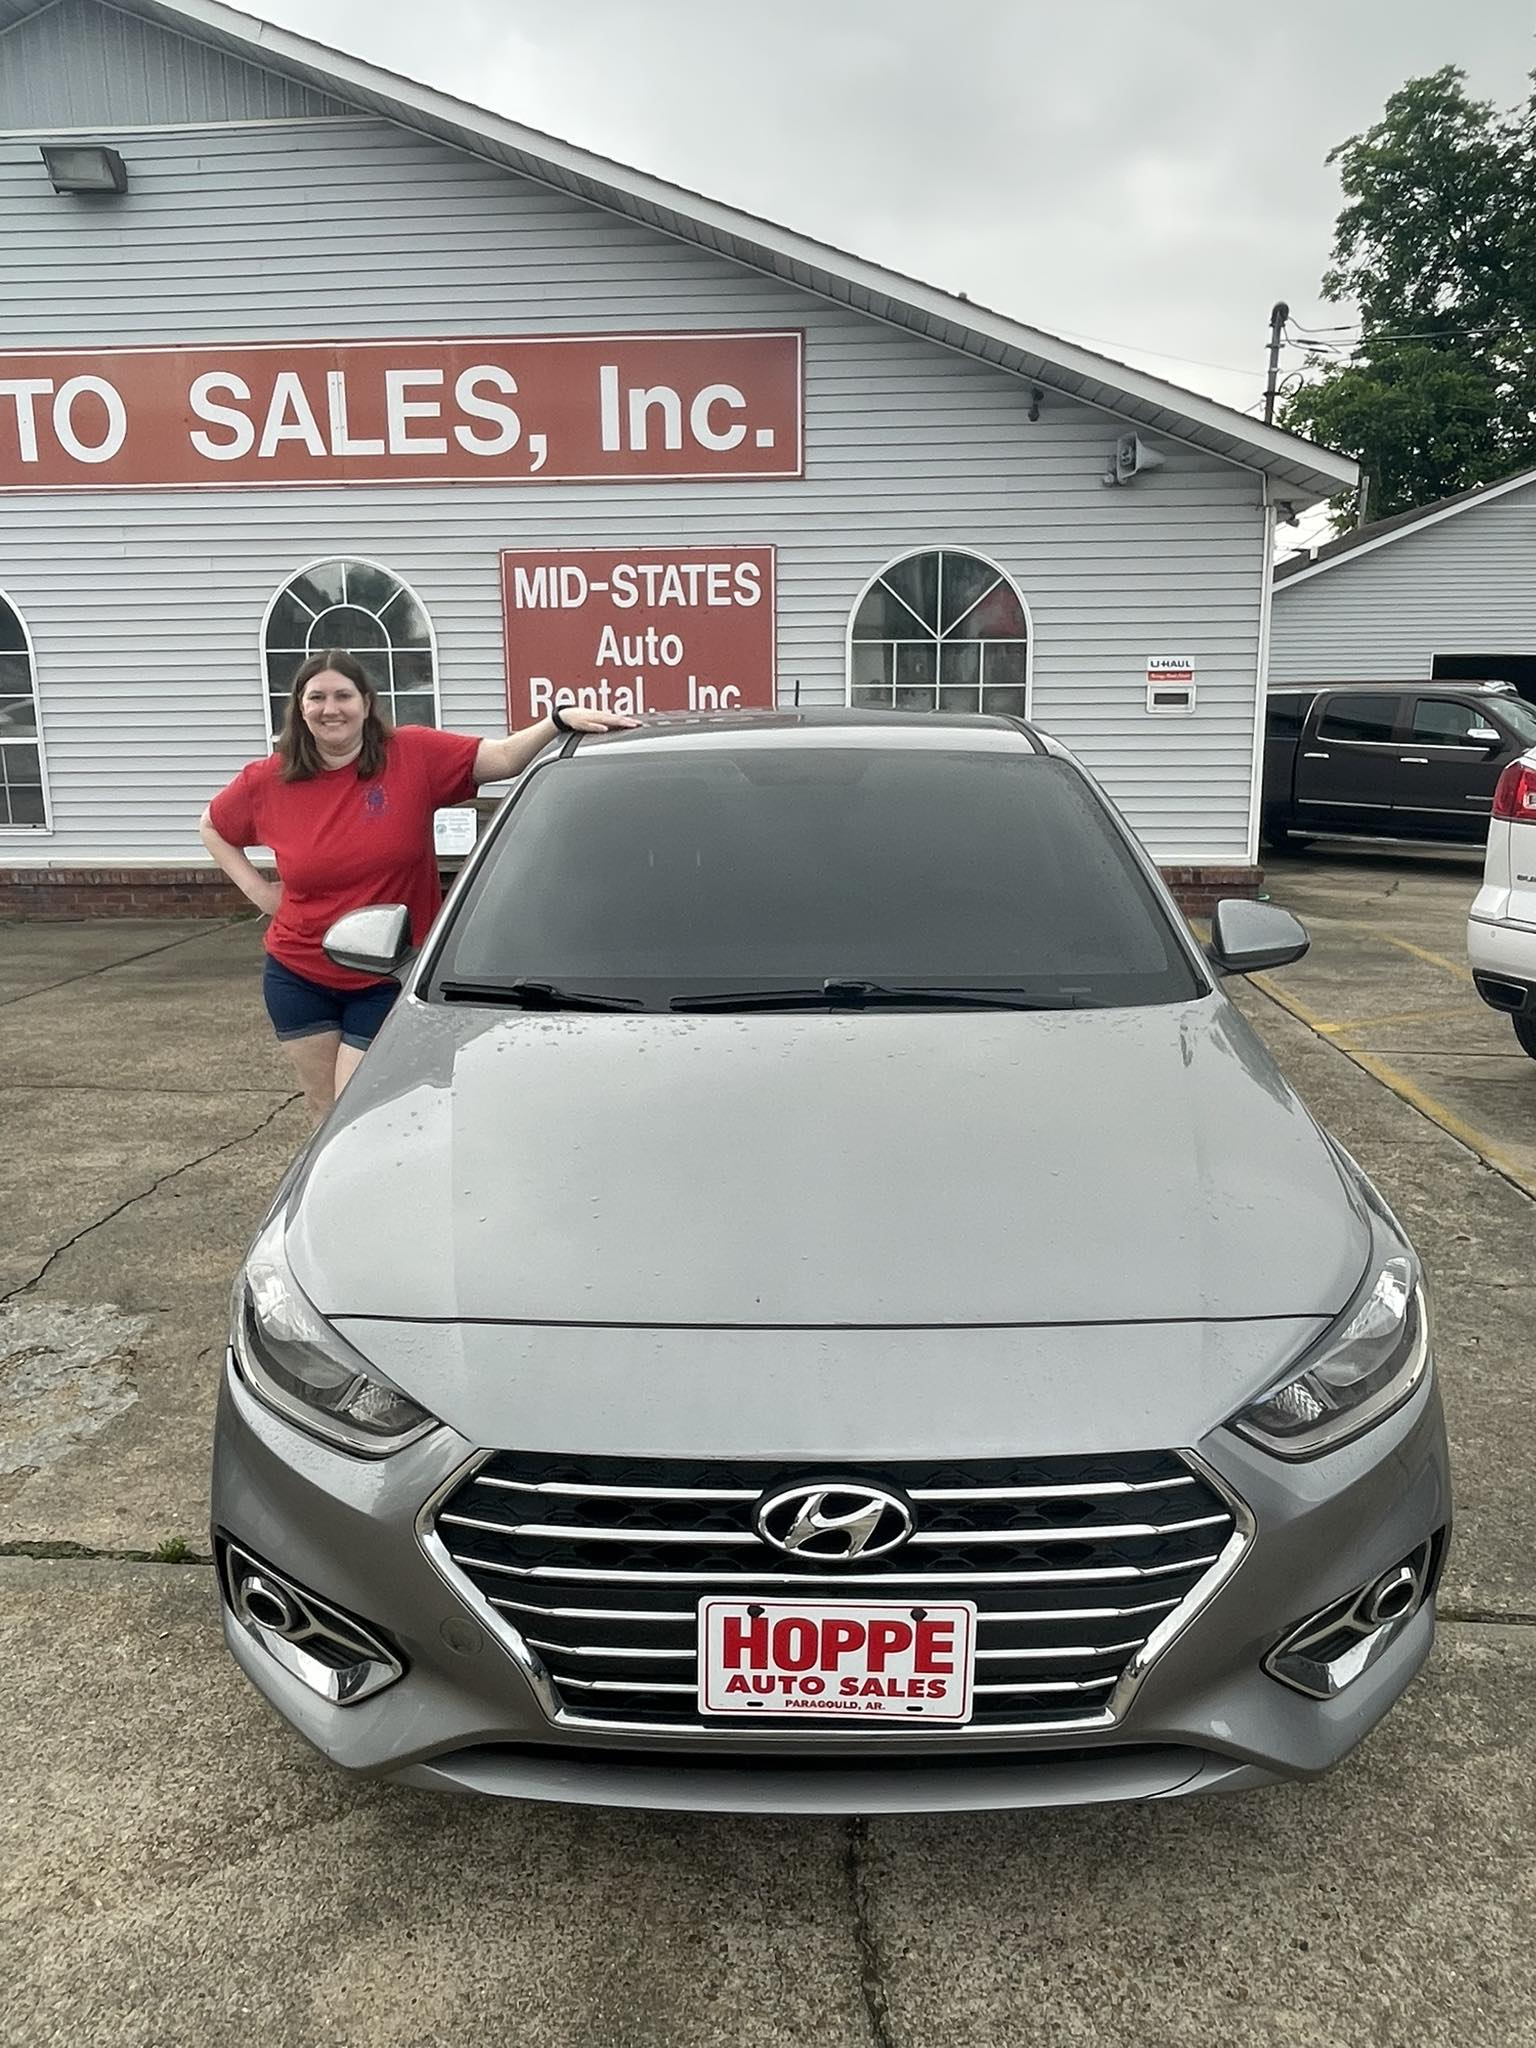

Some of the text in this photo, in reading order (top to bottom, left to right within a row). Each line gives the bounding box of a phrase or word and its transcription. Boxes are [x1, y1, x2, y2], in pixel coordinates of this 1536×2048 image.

[0, 365, 775, 472] TO SALES, Inc.
[514, 562, 762, 609] MID-STATES
[595, 625, 683, 666] Auto
[723, 1616, 954, 1674] HOPPE
[725, 1674, 947, 1699] AUTO SALES
[785, 1699, 886, 1711] PARAGOULD, AR.
